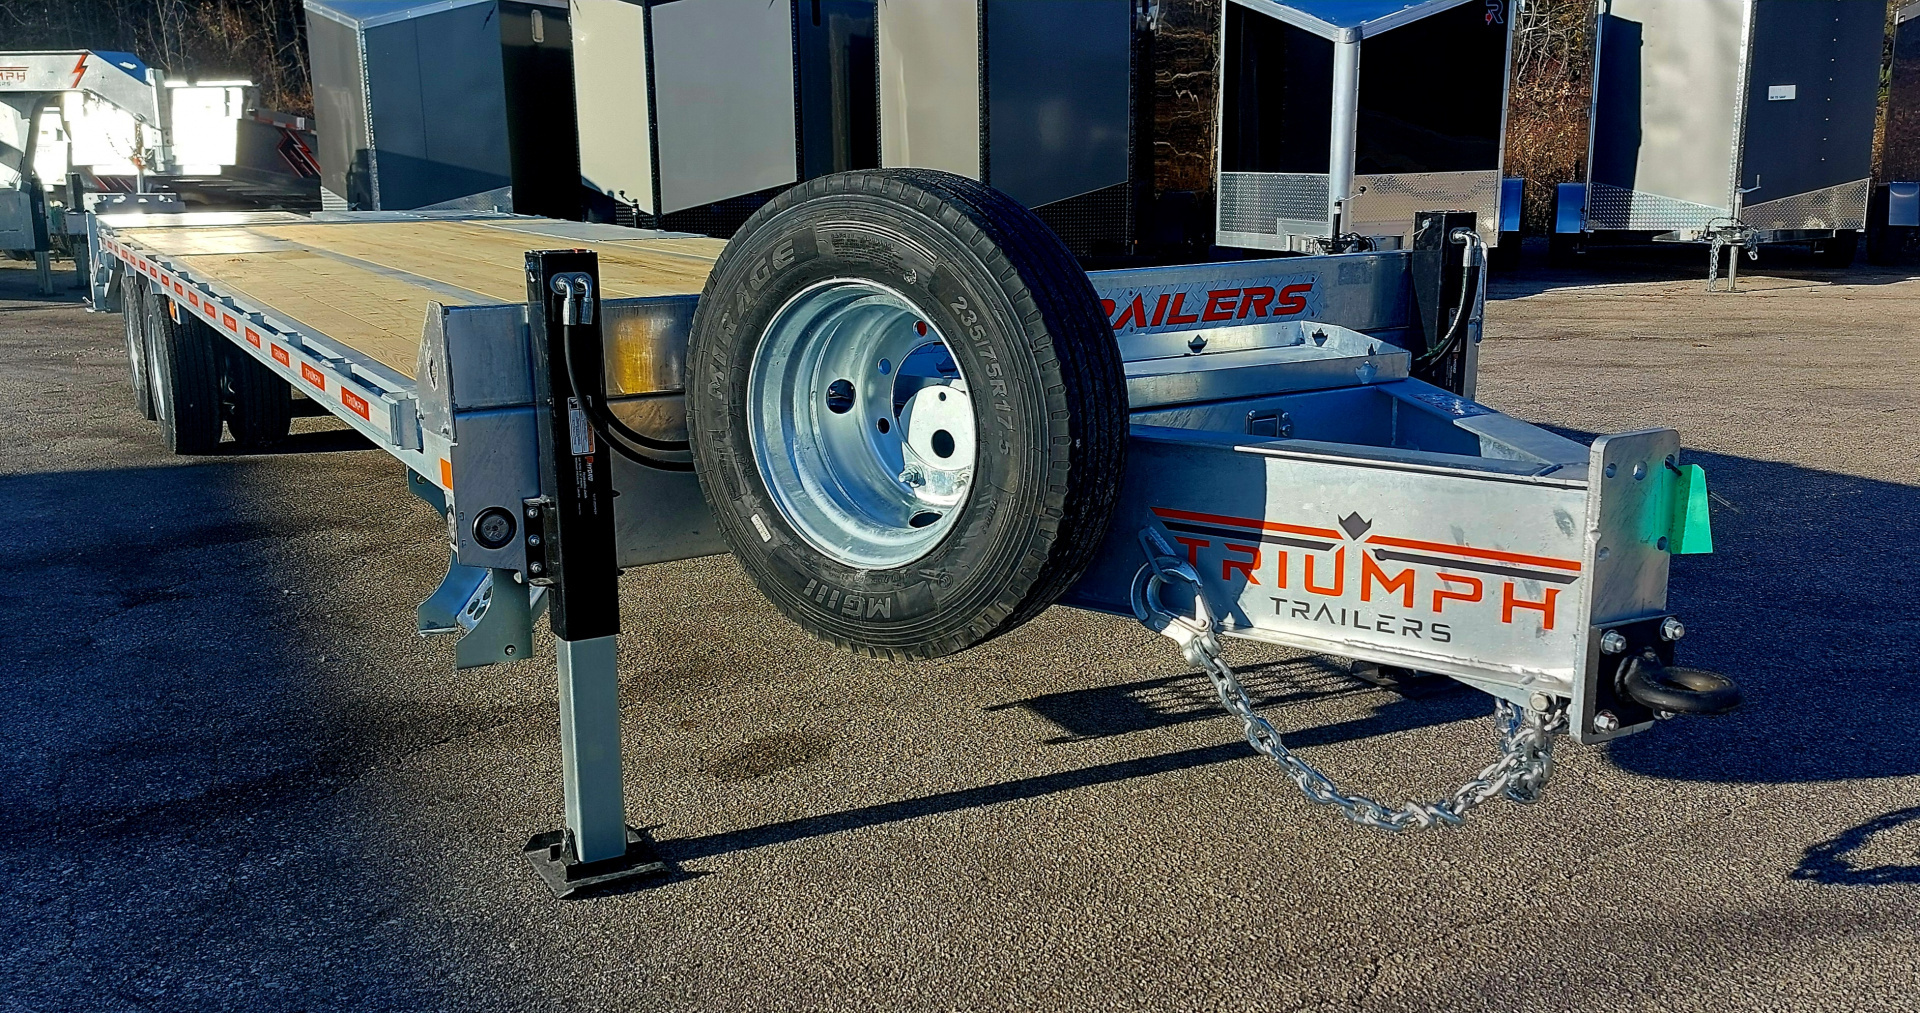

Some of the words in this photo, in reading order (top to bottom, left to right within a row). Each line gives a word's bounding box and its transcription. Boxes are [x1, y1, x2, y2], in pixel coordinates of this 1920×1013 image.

[708, 238, 795, 400] MIRAGE
[345, 393, 365, 414] TRIUMPH
[1174, 535, 1562, 630] TRIUMPH
[1269, 596, 1451, 643] TRAILERS
